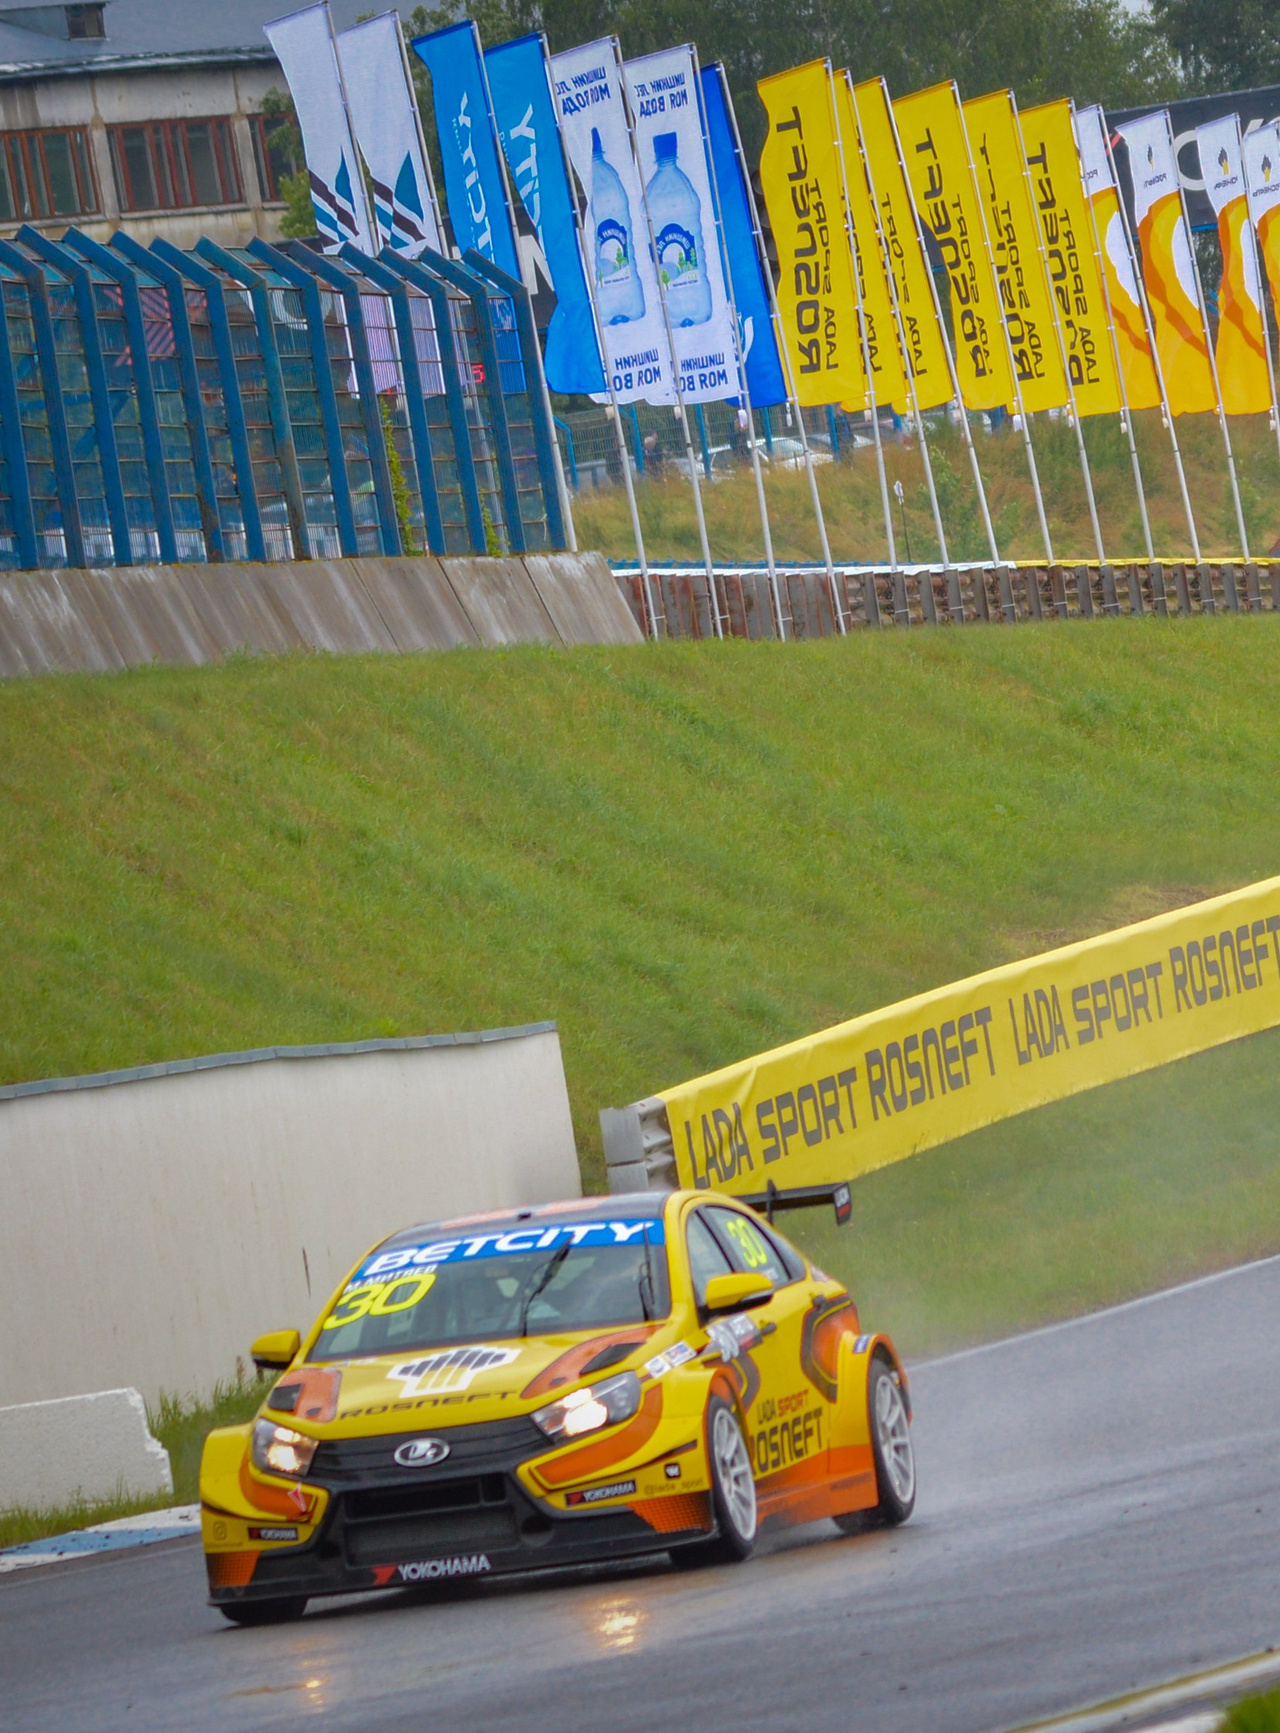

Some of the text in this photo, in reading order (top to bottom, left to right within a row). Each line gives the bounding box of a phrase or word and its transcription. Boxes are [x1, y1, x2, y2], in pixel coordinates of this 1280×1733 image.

[1009, 985, 1070, 1065] LADA
[1072, 961, 1163, 1046] SPORT
[685, 1006, 995, 1190] LADA SPORT ROSNEFT
[363, 1220, 656, 1277] BETCITY
[726, 1218, 768, 1268] 30
[322, 1273, 437, 1330] 30
[339, 1391, 518, 1421] ROSNEFT
[397, 1553, 491, 1581] YOKOHAMA
